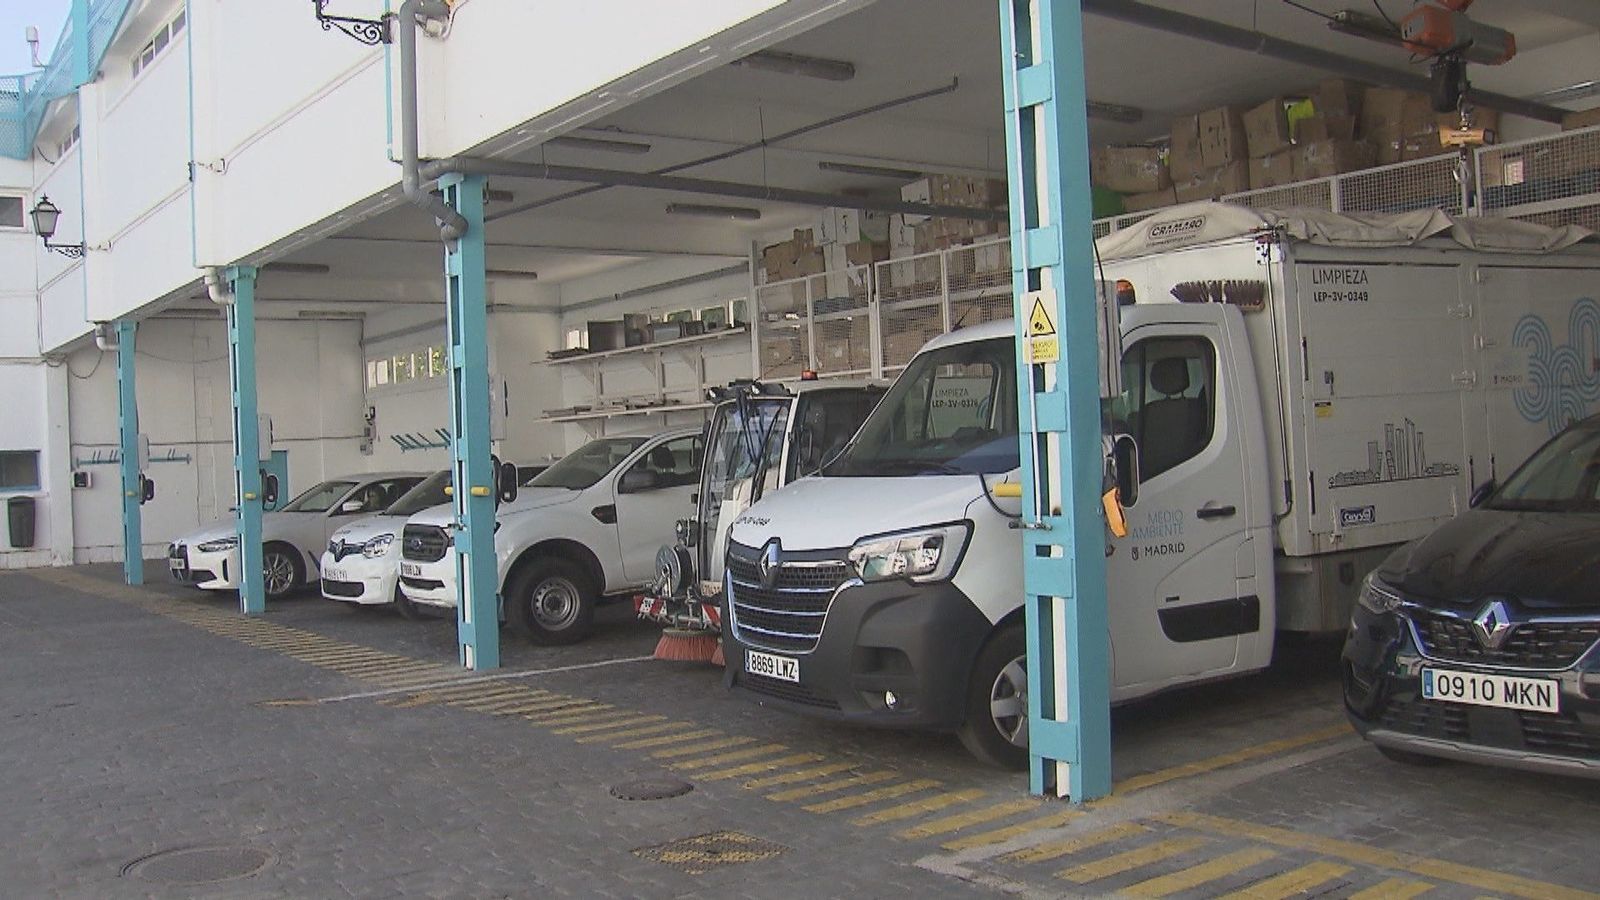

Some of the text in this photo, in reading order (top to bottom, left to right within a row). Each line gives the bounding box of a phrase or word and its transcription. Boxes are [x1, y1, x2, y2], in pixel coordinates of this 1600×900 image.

[1151, 218, 1203, 236] CRAMARO
[1312, 268, 1368, 285] LIMPIEZA
[1313, 291, 1369, 303] LEP-3V-0349
[934, 388, 969, 398] LIMPIEZA
[1148, 510, 1183, 525] MEDIO
[1132, 523, 1184, 540] AMBIENTE
[1144, 543, 1185, 557] MADRID
[751, 654, 795, 679] 8869 LWZ
[1437, 675, 1551, 707] 0910 MKN
